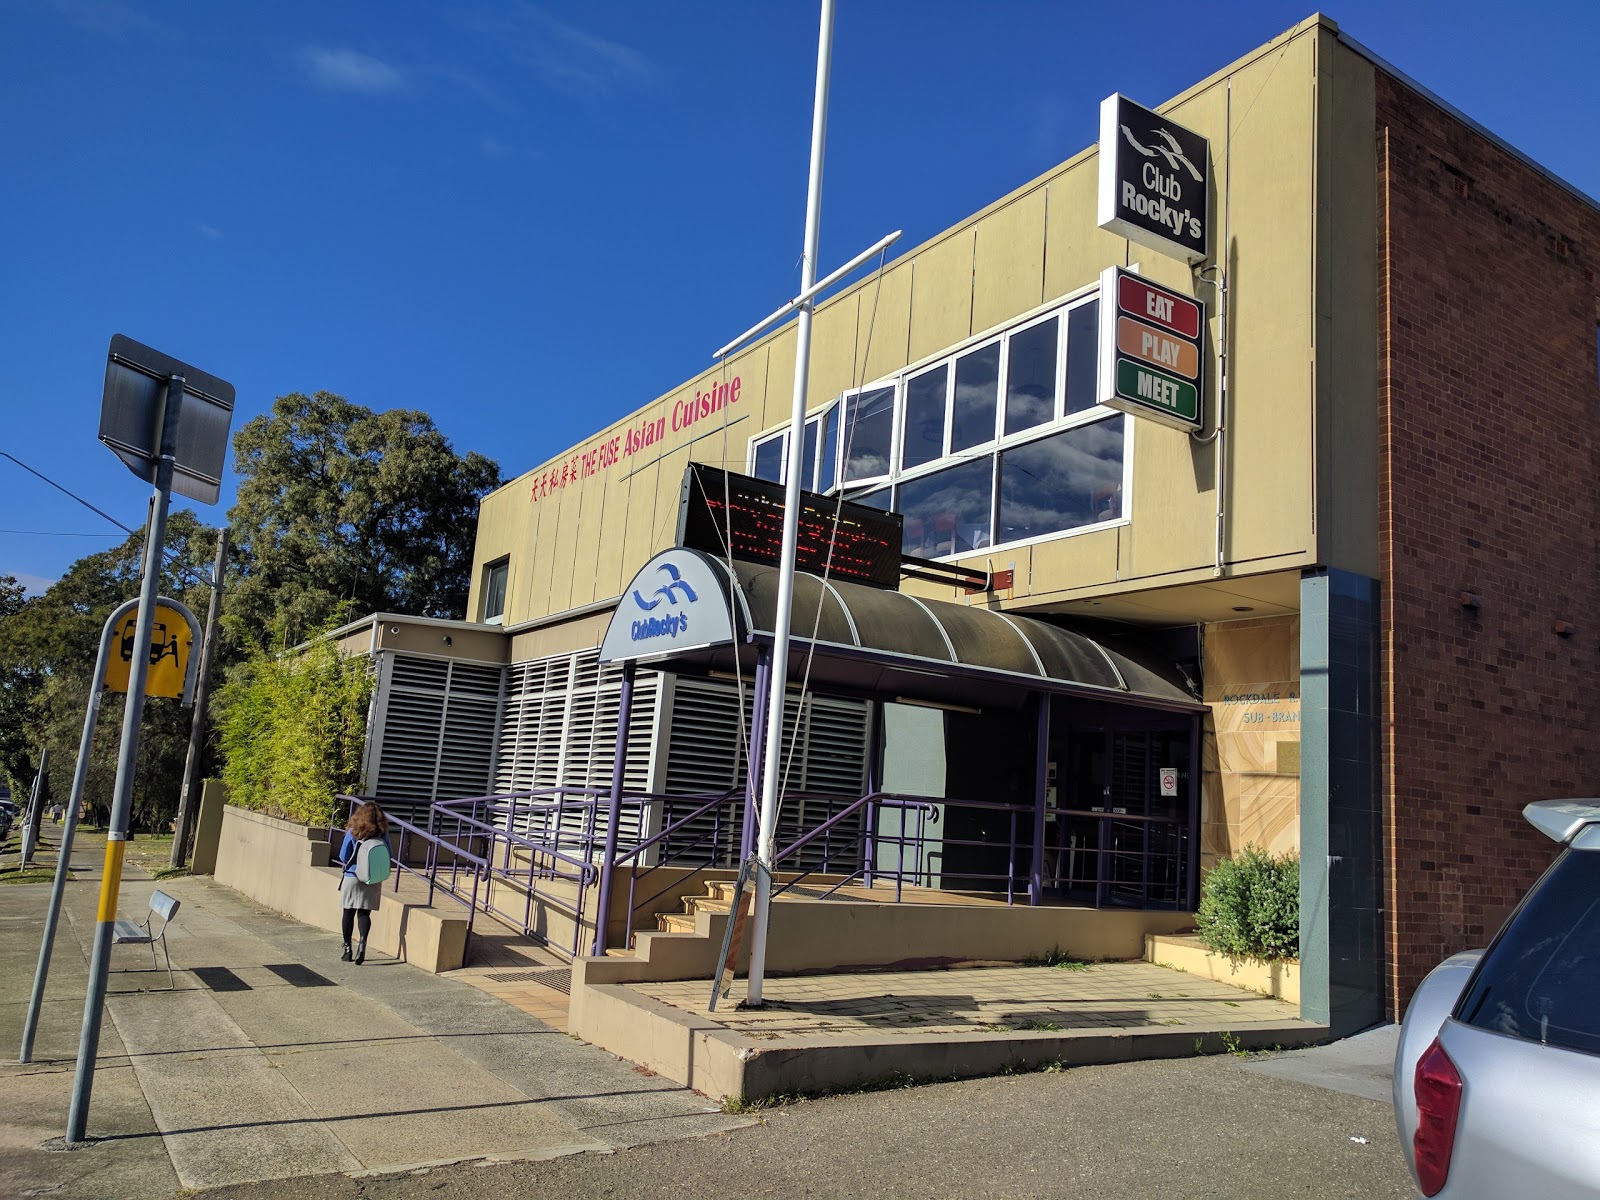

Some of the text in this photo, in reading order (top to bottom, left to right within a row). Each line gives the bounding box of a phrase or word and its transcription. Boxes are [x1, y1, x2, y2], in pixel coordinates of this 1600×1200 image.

[1142, 161, 1182, 202] Club
[1121, 180, 1202, 239] Rocky's
[1146, 291, 1175, 324] EAT
[1141, 331, 1180, 368] PLAY
[1137, 371, 1180, 408] MEET
[581, 376, 741, 480] THE FUSE Asian Cuisine
[1224, 693, 1280, 705] ROCKDALE
